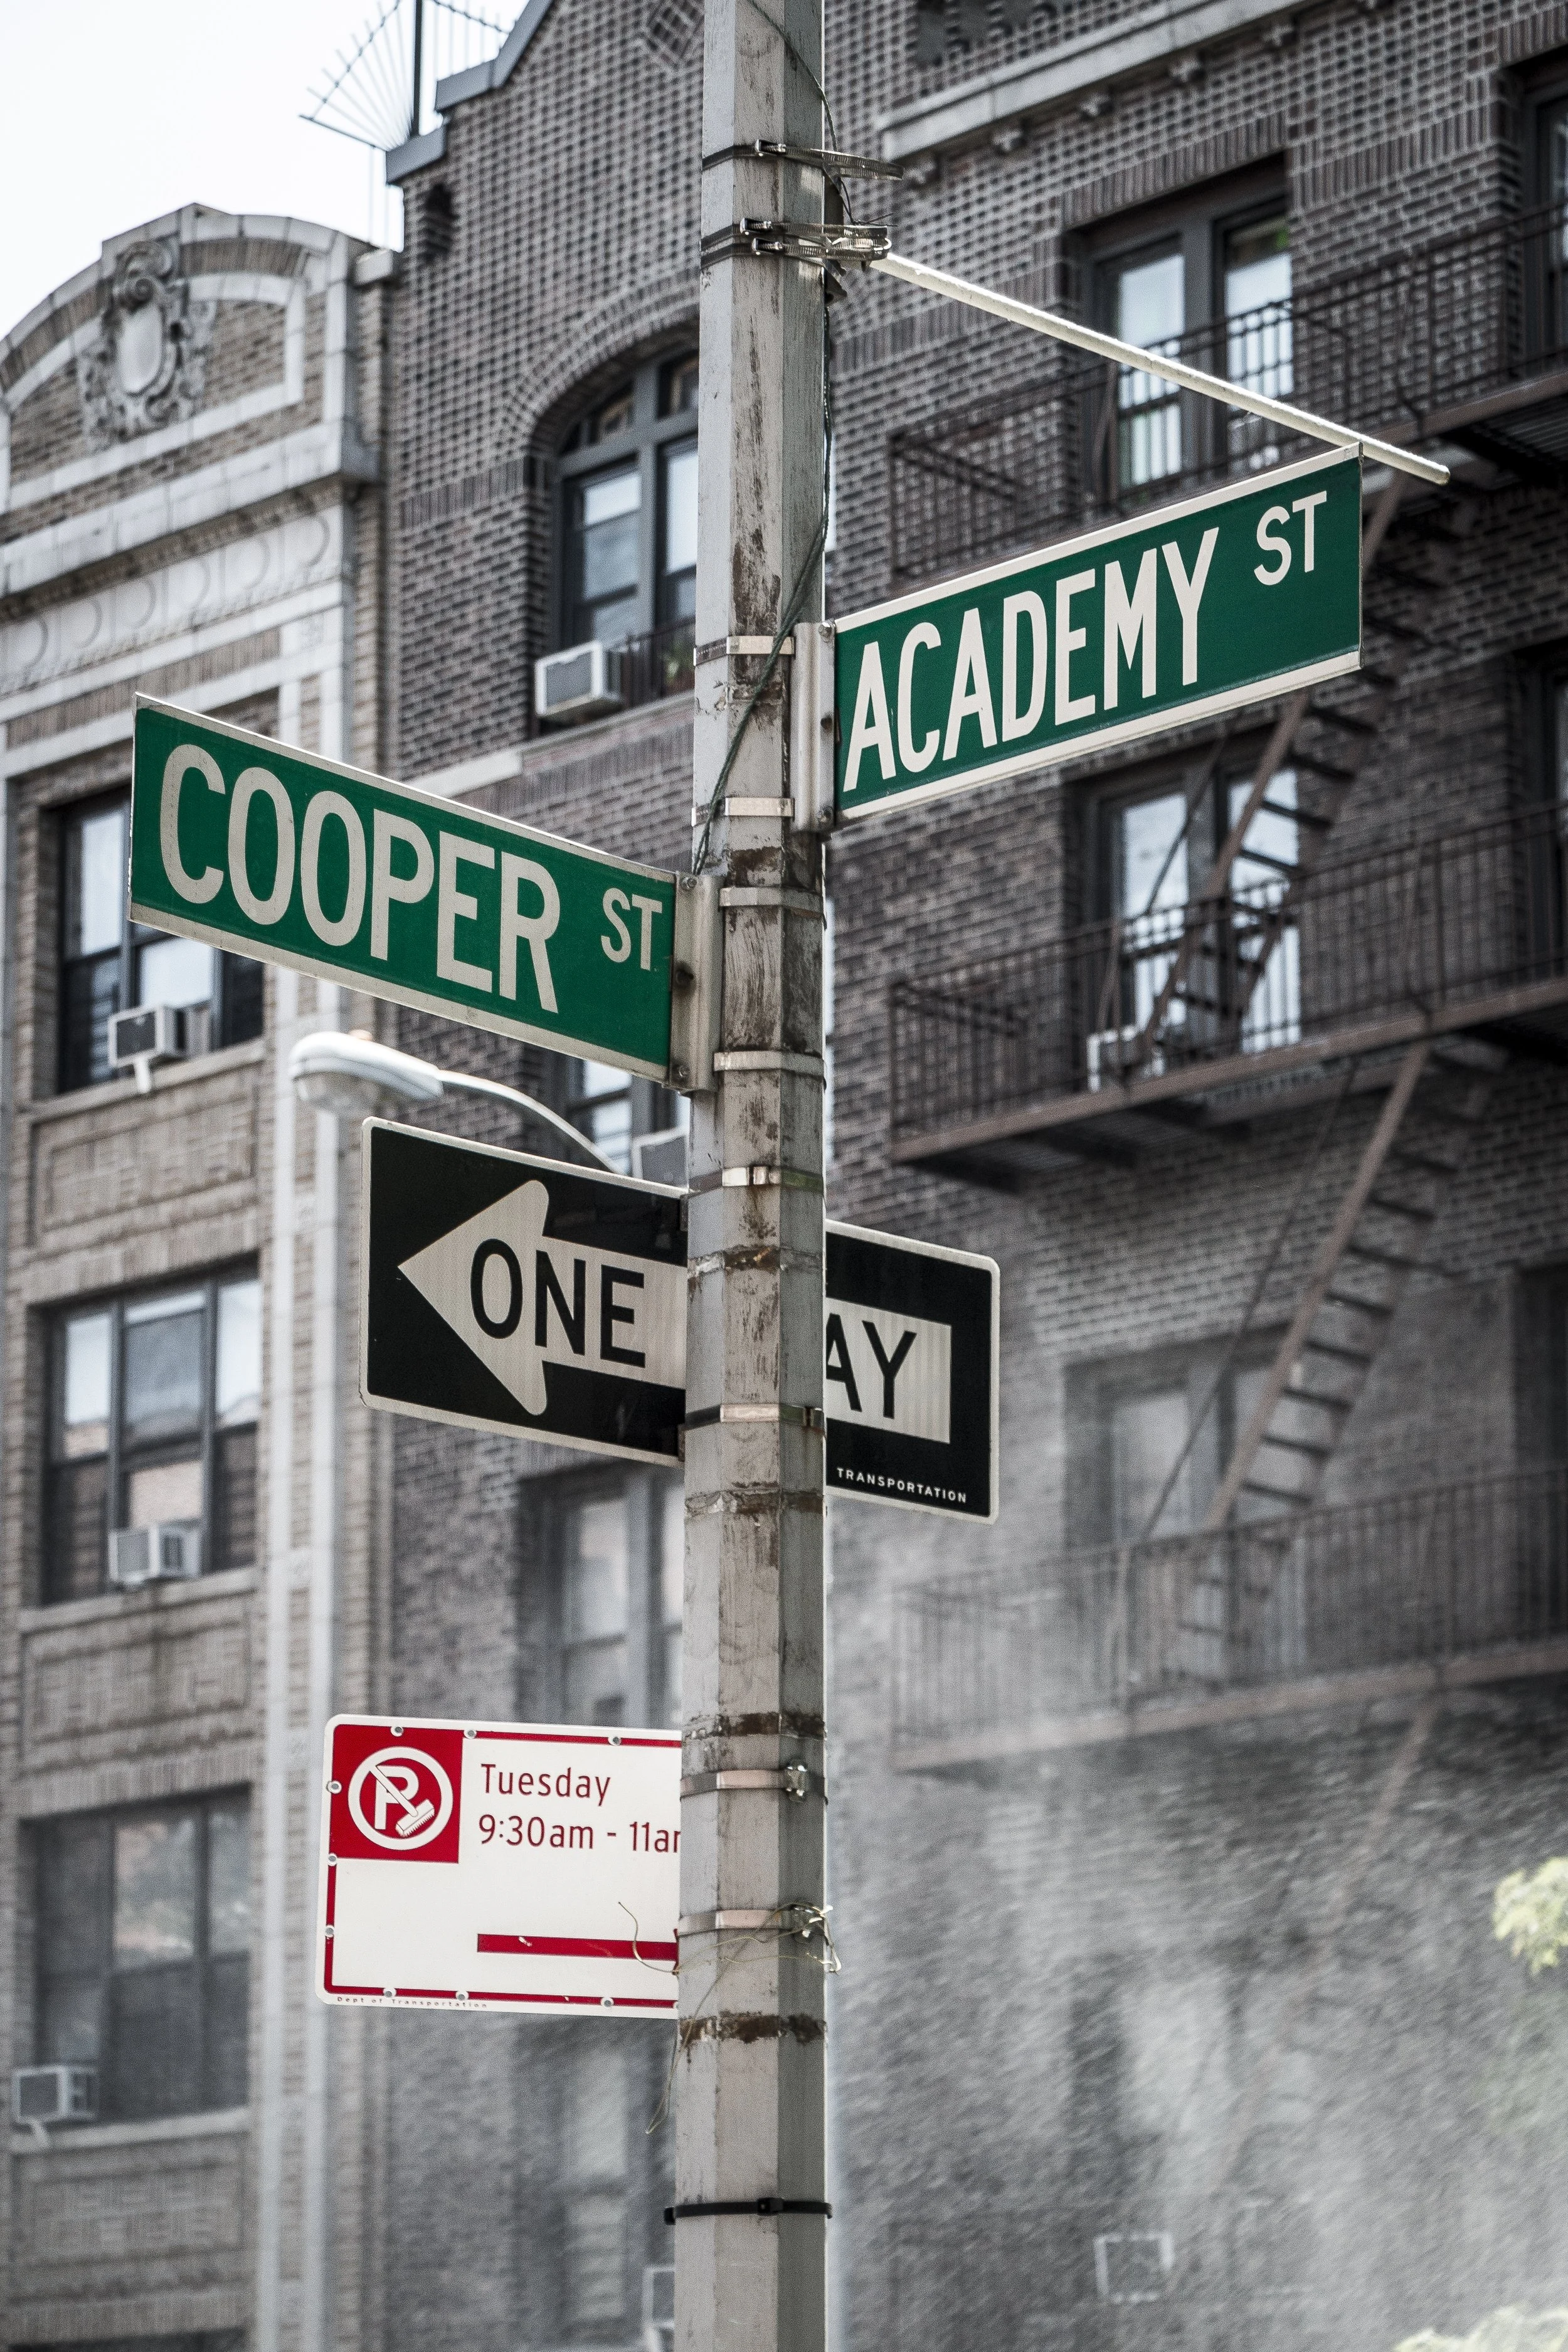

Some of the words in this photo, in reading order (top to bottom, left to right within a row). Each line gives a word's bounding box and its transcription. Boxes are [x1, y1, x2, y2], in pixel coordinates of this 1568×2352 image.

[842, 527, 1219, 793] ACADEMY
[1254, 490, 1327, 586] ST
[160, 744, 560, 1014] COOPER
[600, 887, 663, 971] ST
[470, 1238, 646, 1369] ONE
[825, 1312, 917, 1419] AY
[837, 1467, 966, 1503] TRANSPORTATION
[480, 1763, 611, 1806] Tuesday
[479, 1814, 593, 1849] 9:30am
[391, 1999, 487, 2008] Transportation
